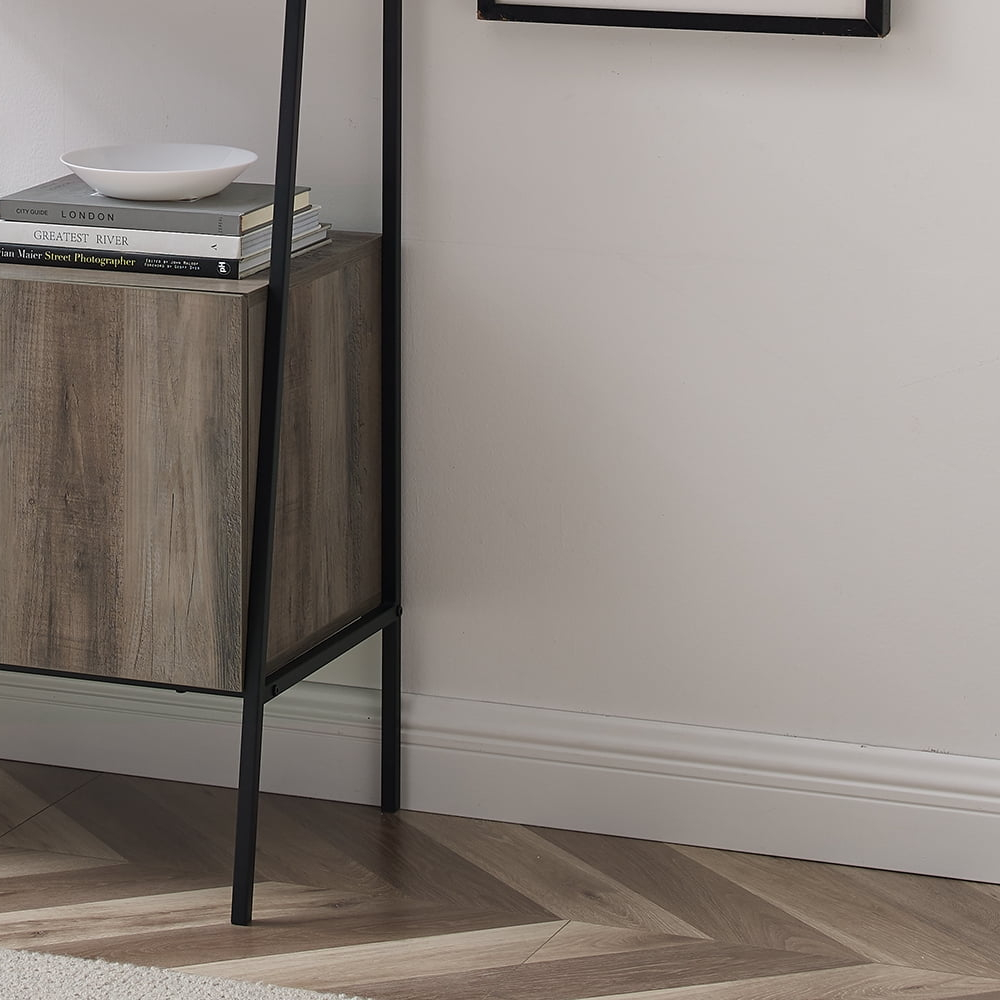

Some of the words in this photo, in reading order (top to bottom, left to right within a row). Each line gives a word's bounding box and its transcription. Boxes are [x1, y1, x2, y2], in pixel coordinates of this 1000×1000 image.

[61, 210, 115, 222] LONDON
[33, 230, 90, 243] GREATEST
[96, 235, 129, 246] RIVER
[17, 248, 43, 260] Maier
[44, 250, 72, 262] Street
[74, 252, 137, 268] Photographer
